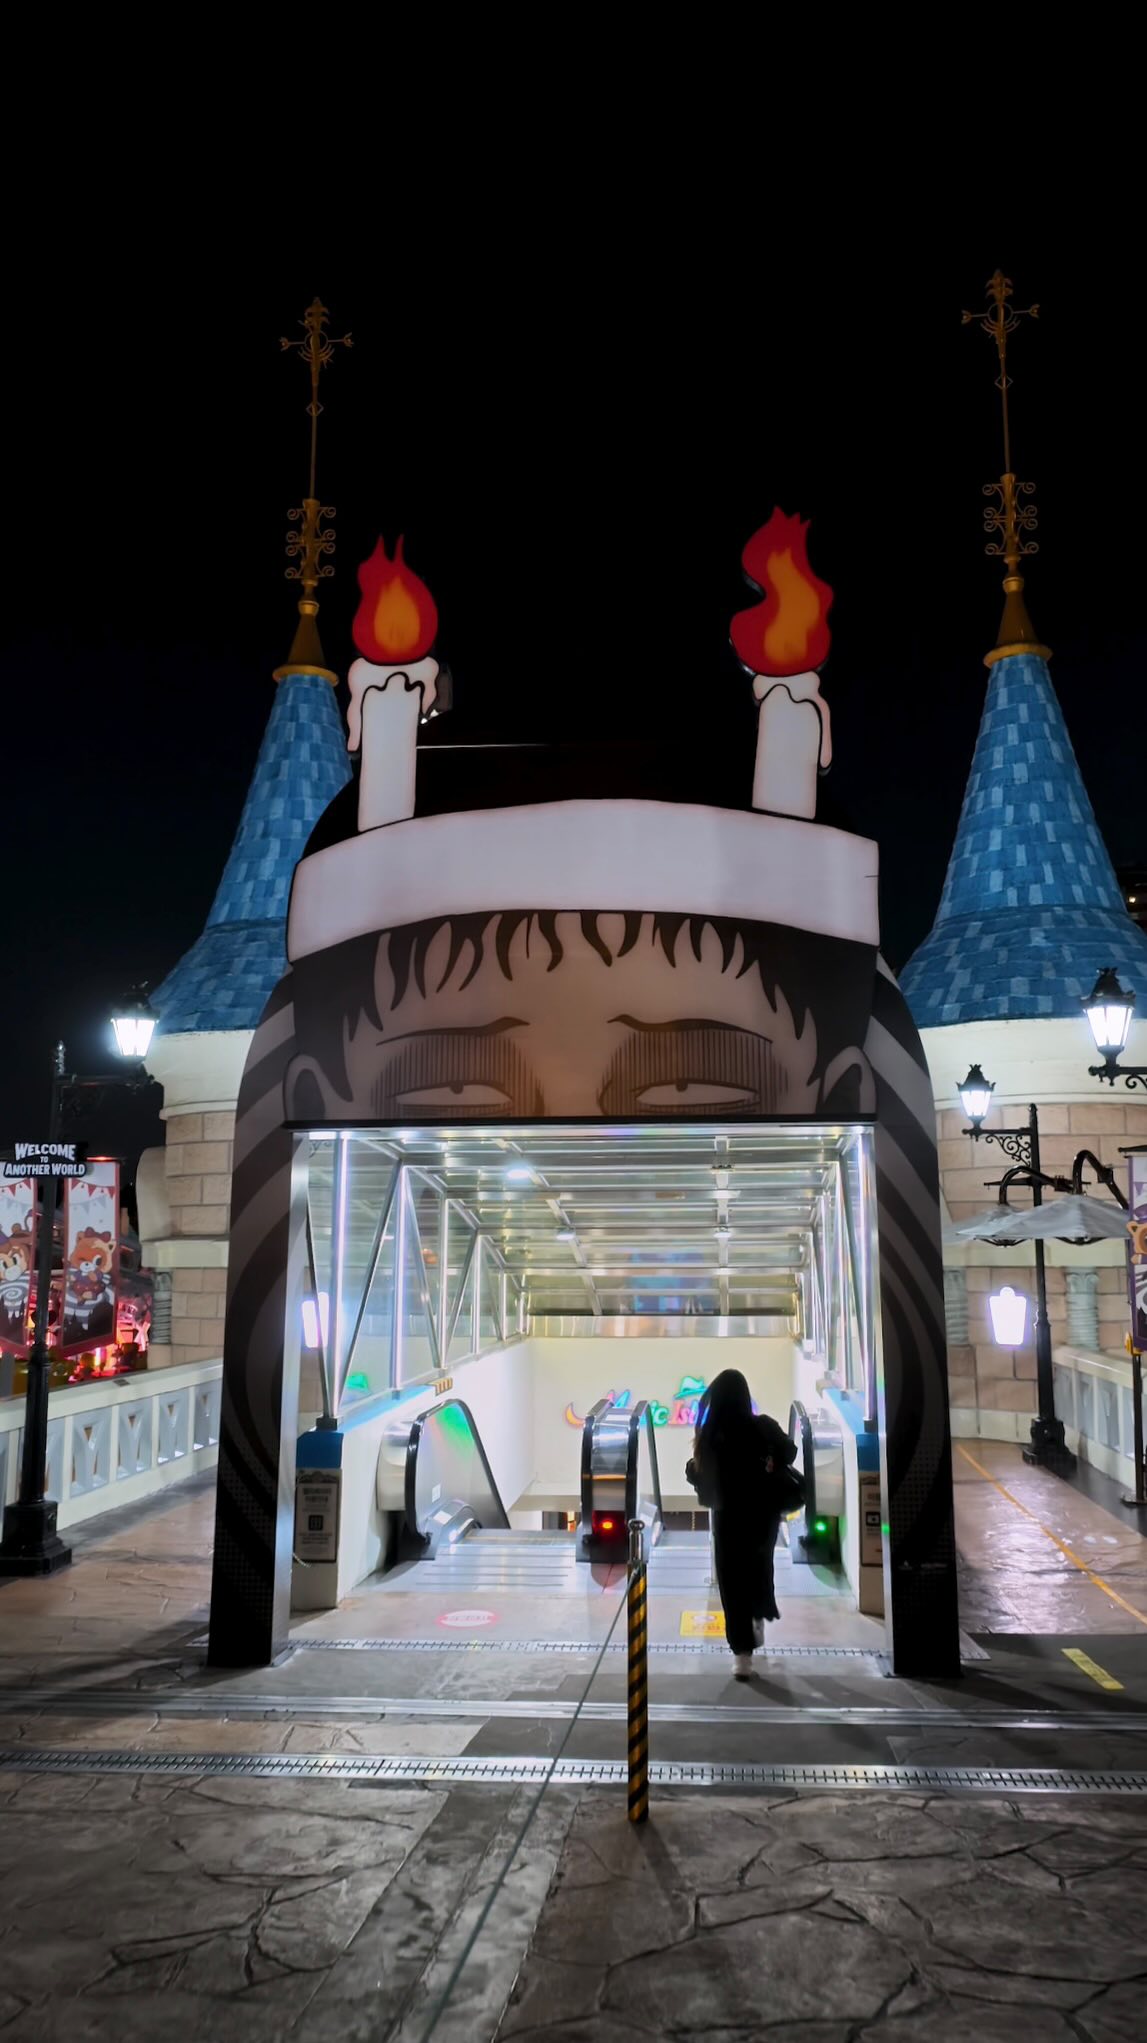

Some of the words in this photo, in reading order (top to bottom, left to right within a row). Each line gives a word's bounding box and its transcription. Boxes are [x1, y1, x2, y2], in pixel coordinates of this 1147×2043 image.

[15, 1143, 76, 1161] WELCOME
[5, 1163, 50, 1175] ANOTHER
[52, 1163, 86, 1175] WORLD
